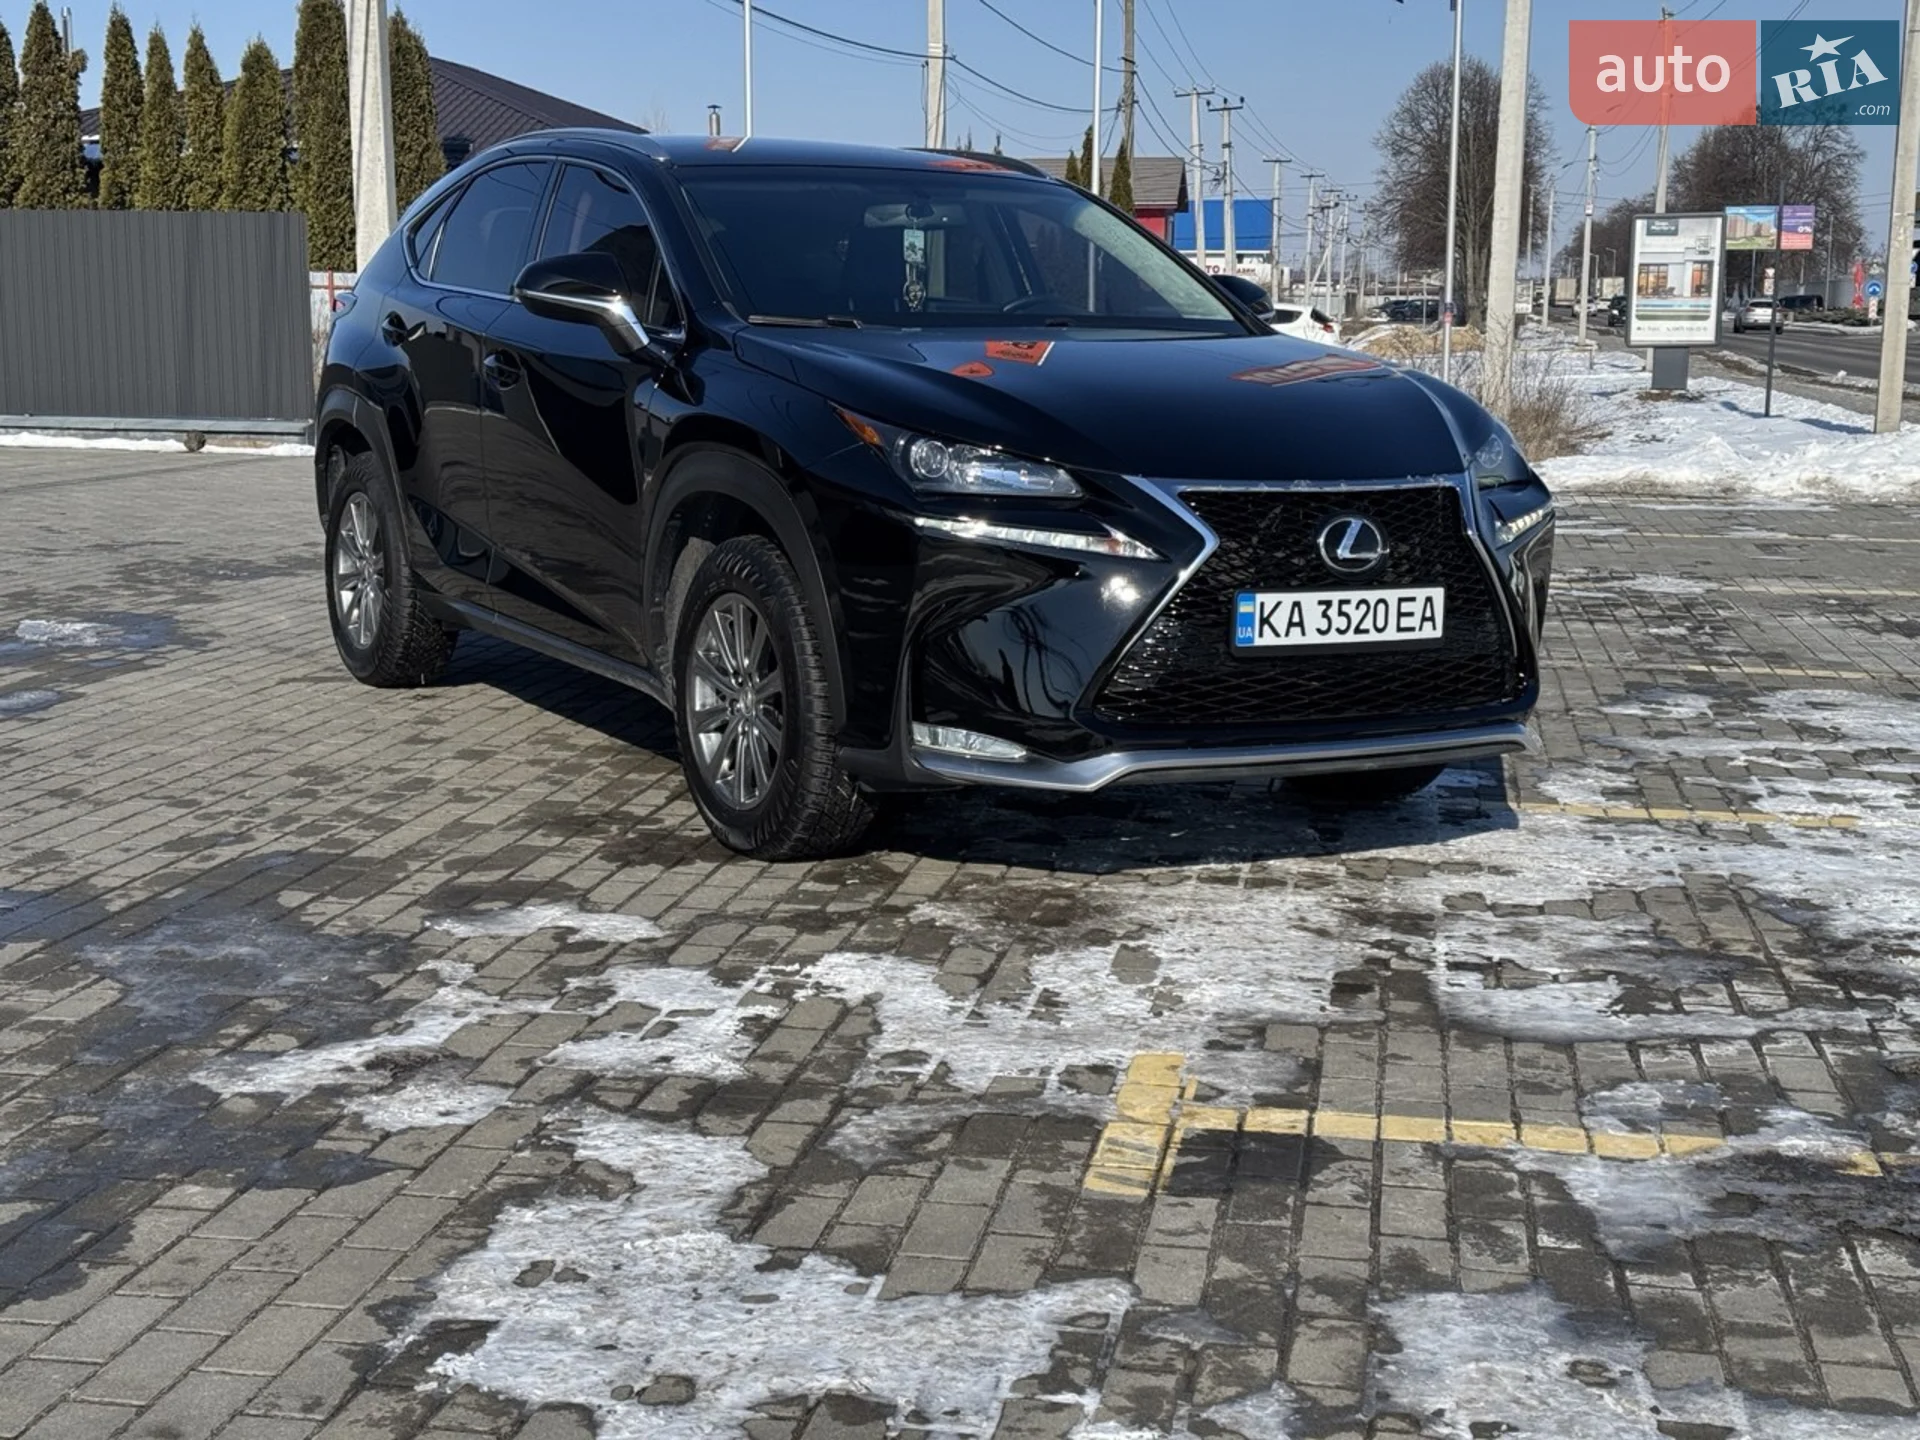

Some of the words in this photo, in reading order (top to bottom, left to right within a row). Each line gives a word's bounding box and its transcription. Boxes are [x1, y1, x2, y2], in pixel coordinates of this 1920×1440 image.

[1258, 600, 1306, 638] KA
[1315, 598, 1389, 636] 3520
[1396, 596, 1437, 633] EA
[1237, 626, 1253, 638] UA
